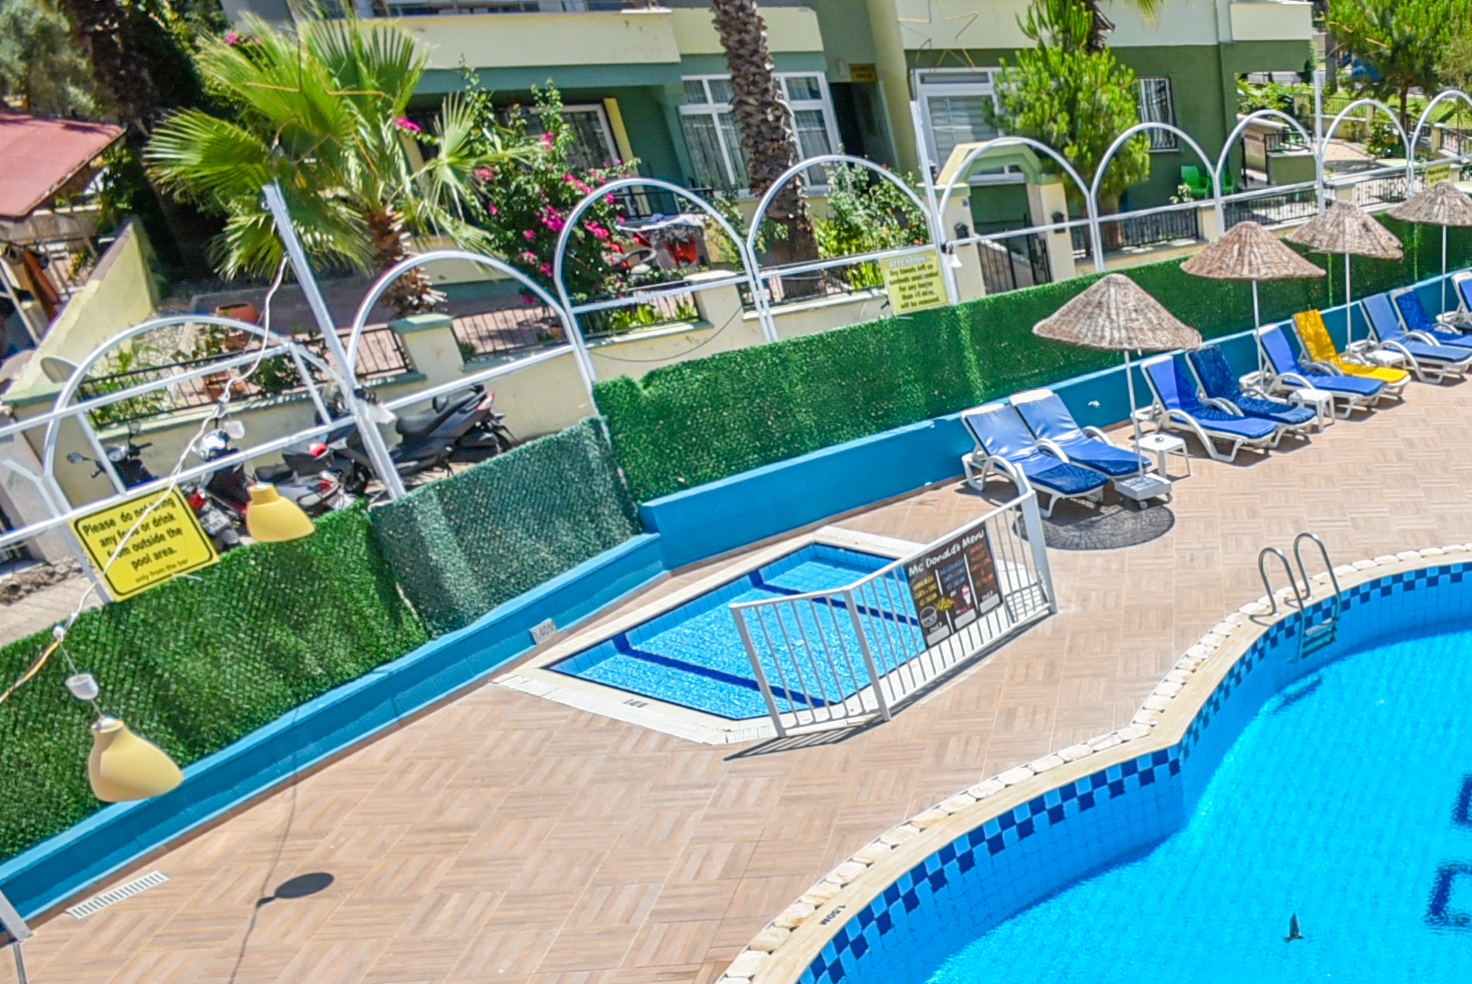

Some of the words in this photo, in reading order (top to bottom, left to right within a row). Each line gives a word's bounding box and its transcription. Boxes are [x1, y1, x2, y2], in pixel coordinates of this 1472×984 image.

[82, 518, 116, 537] Please
[120, 511, 134, 523] do
[99, 534, 118, 548] any
[141, 523, 152, 533] or
[152, 512, 177, 528] drink
[132, 532, 167, 551] outside
[166, 526, 184, 539] the
[131, 554, 153, 572] pool
[153, 546, 178, 561] area.
[908, 563, 924, 577] Mc
[925, 543, 961, 569] Donald's
[962, 529, 985, 549] Menu
